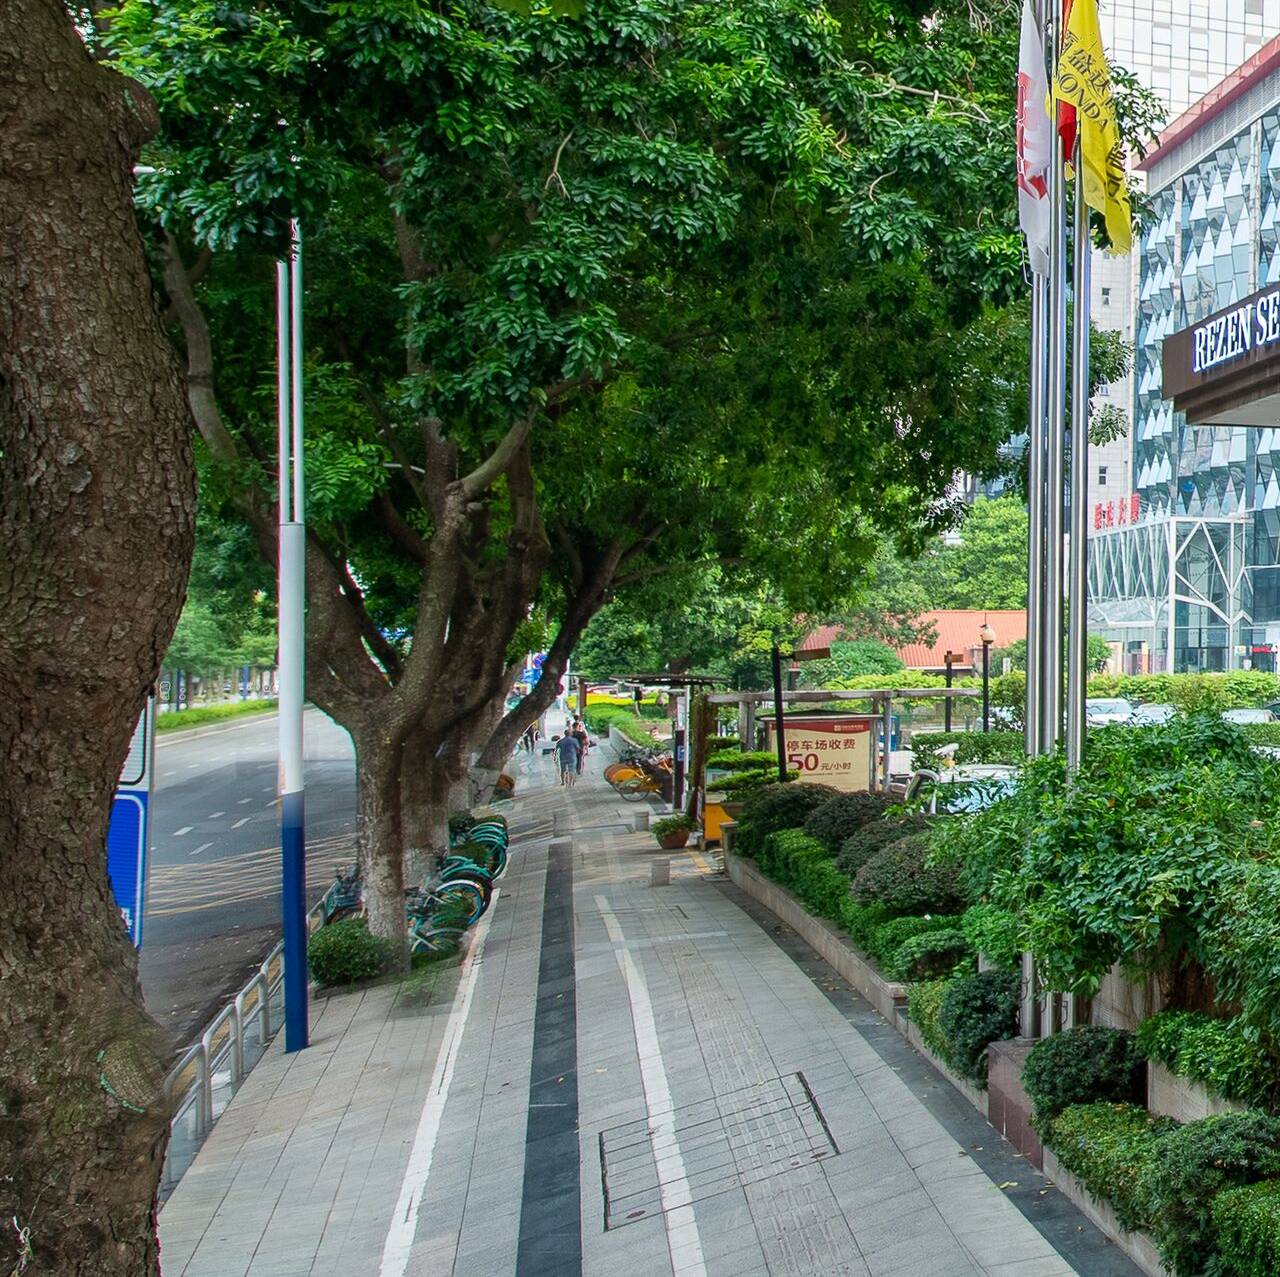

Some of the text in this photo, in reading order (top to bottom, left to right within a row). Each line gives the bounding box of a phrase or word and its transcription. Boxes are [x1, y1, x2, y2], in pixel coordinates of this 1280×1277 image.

[1193, 305, 1252, 372] REZEN
[787, 739, 856, 752] 停车场收费
[788, 753, 852, 771] 50 元/小时
